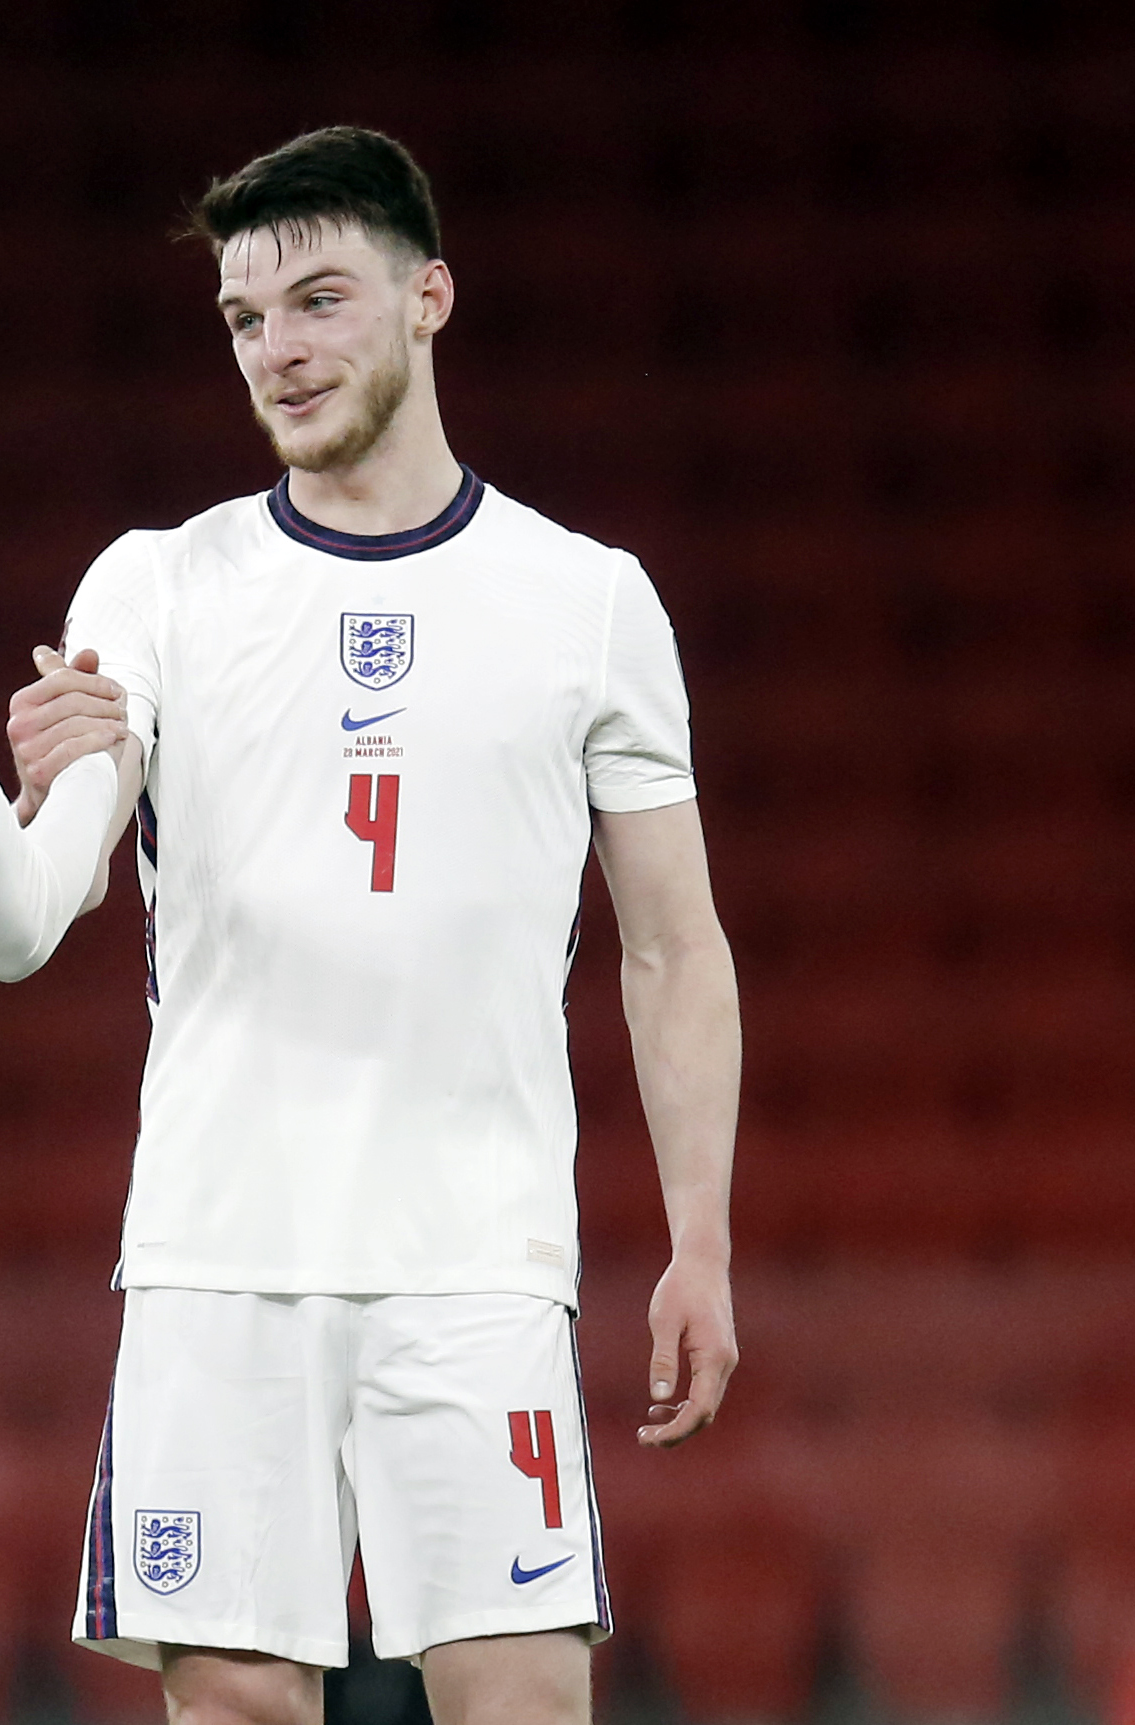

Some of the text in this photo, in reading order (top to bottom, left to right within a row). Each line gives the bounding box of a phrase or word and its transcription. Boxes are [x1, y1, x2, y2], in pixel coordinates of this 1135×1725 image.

[355, 748, 385, 757] MARCH
[386, 747, 404, 757] 2021
[356, 736, 392, 745] ALBANIA
[344, 774, 400, 892] 4
[507, 1410, 563, 1529] 4
